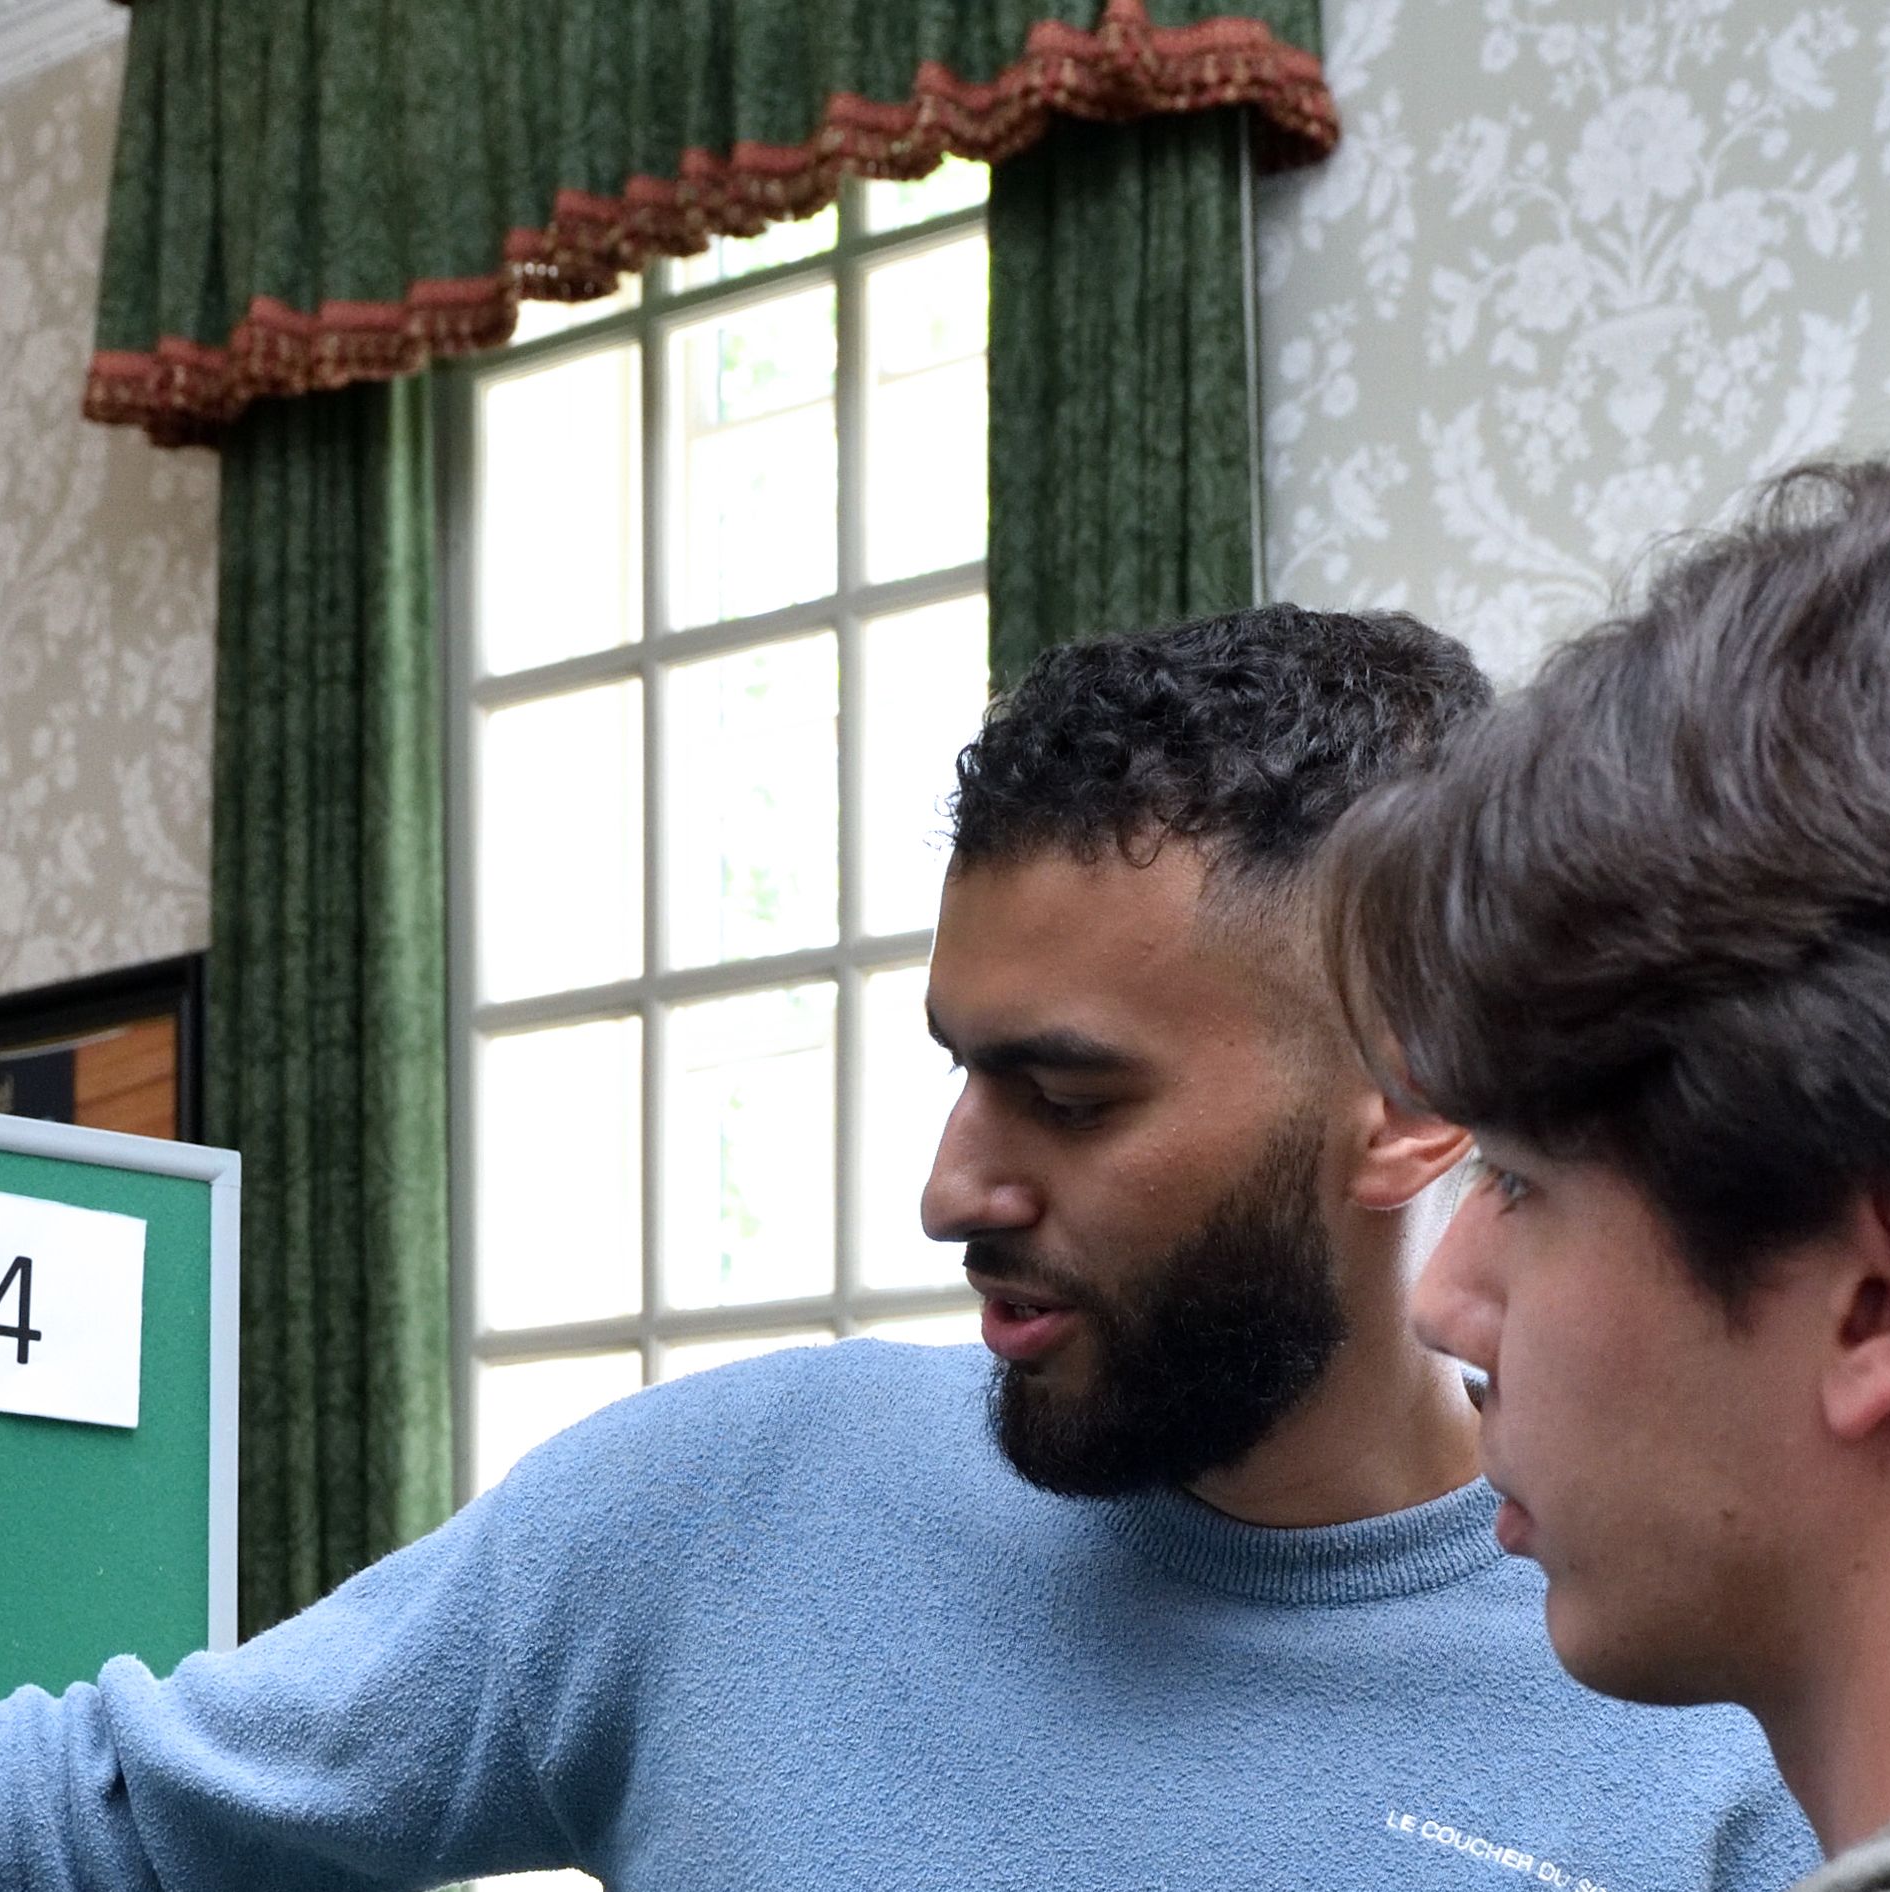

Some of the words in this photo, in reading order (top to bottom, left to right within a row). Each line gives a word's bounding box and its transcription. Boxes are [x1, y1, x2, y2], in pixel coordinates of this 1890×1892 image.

[1386, 1810, 1416, 1834] LE
[1421, 1820, 1533, 1873] COUCHER
[1537, 1861, 1571, 1888] DU
